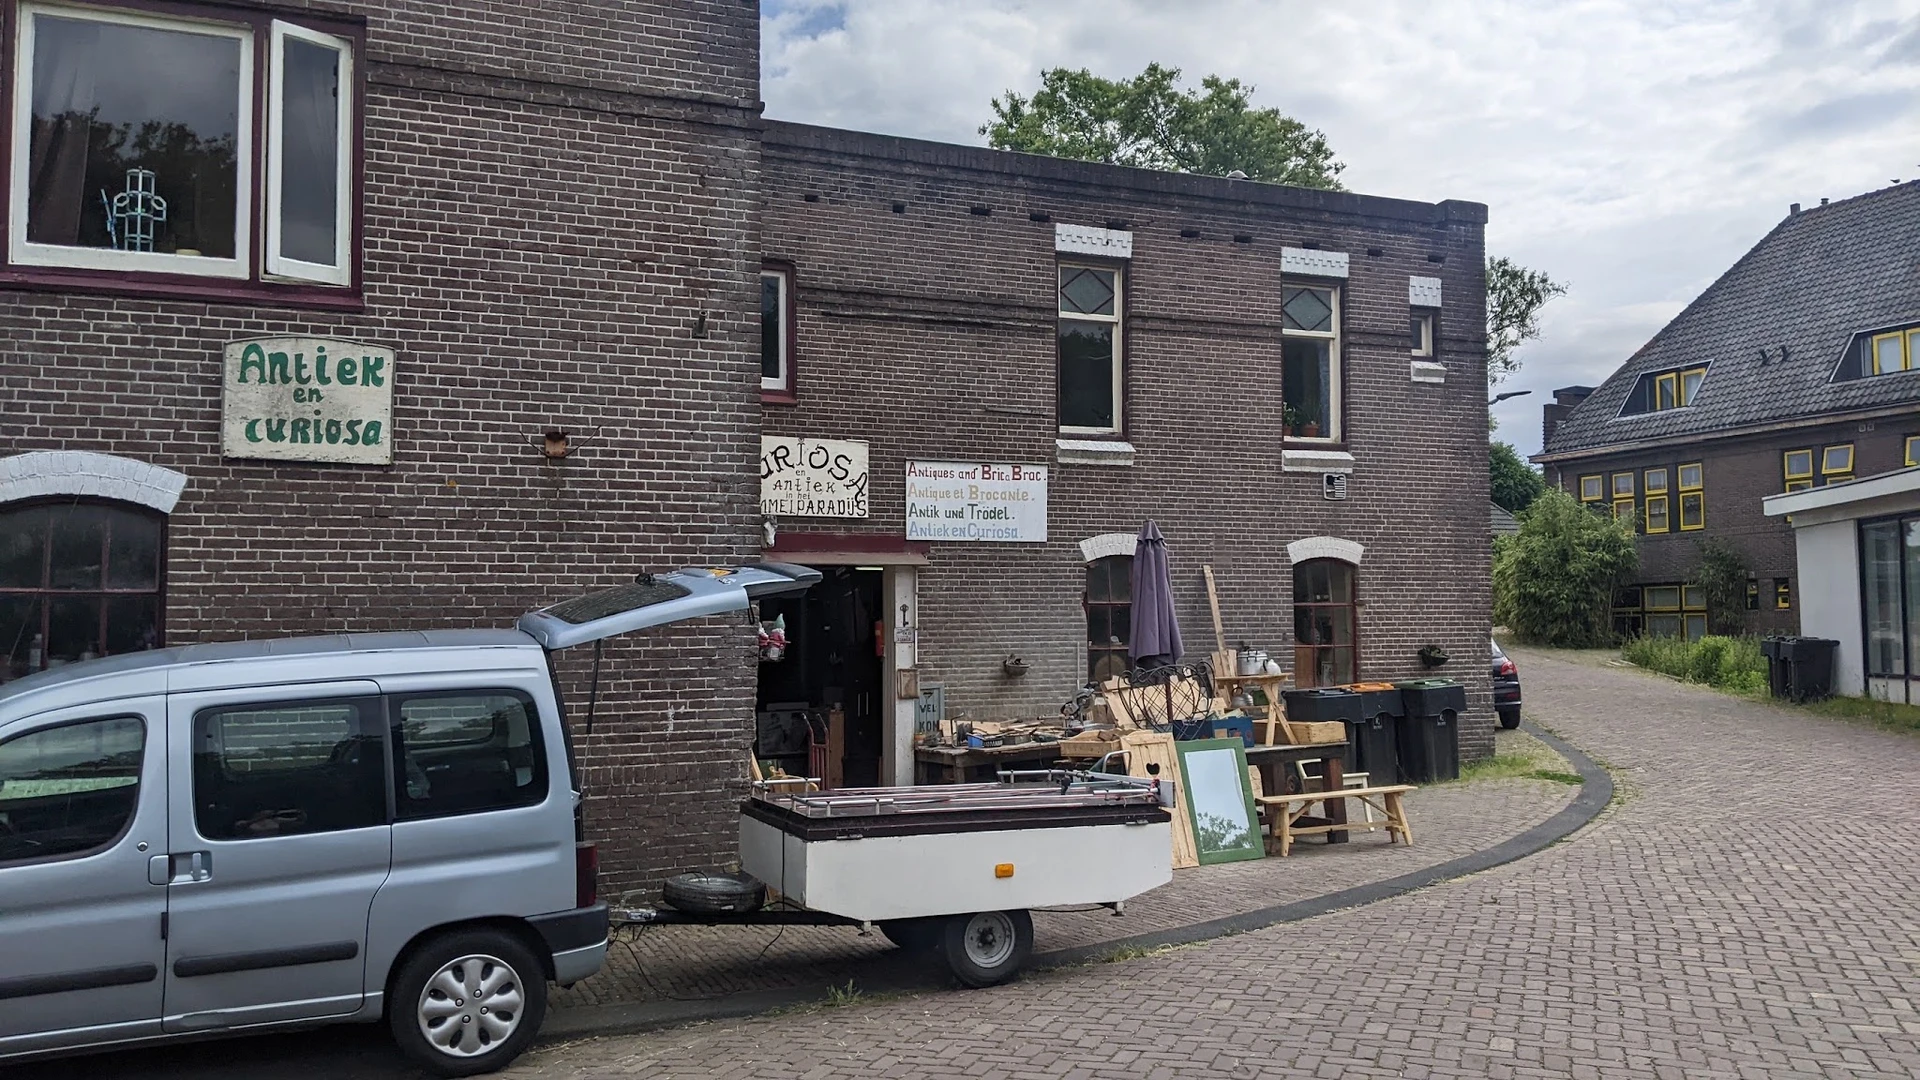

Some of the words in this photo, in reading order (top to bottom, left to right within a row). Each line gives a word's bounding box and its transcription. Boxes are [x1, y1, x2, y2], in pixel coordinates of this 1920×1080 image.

[292, 387, 324, 403] en
[958, 468, 977, 480] and
[981, 464, 1005, 481] Bric
[953, 488, 965, 500] et
